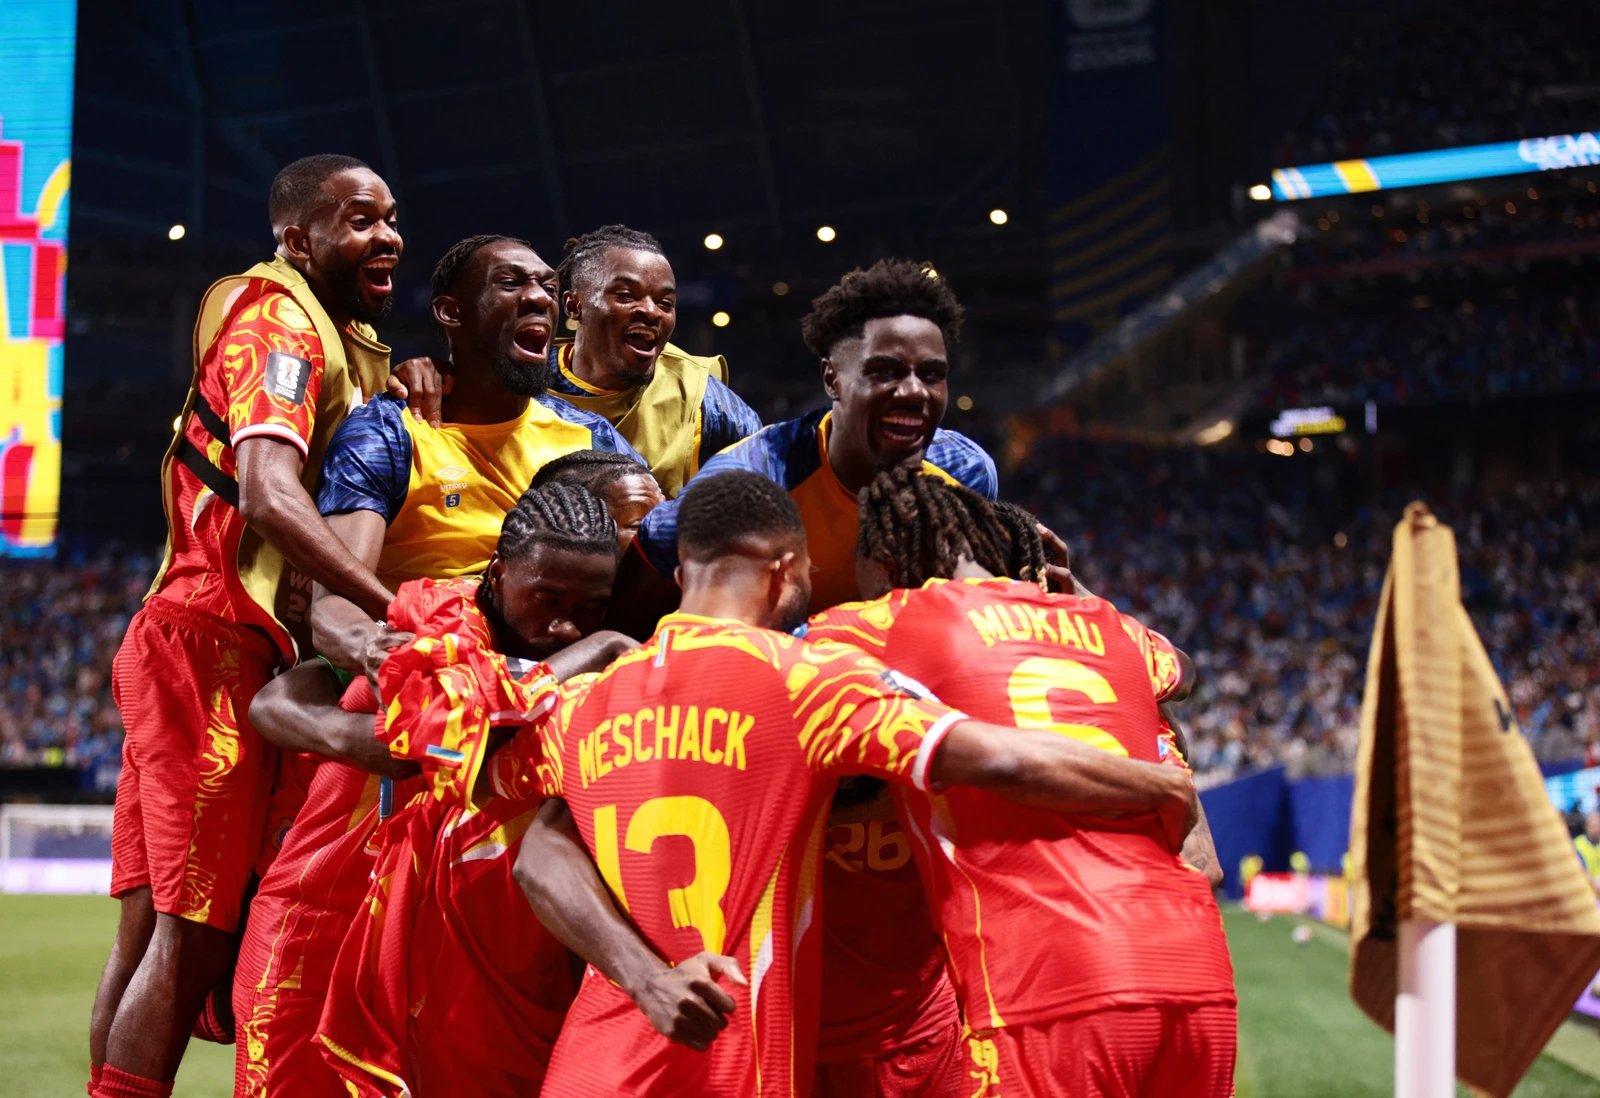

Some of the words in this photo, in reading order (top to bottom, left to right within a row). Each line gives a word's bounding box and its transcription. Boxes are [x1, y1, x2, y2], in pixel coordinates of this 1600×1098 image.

[440, 481, 468, 491] umbro
[449, 495, 456, 506] 5
[968, 603, 1105, 657] MUKAU
[1007, 656, 1129, 758] 6
[578, 705, 755, 790] MESCHACK
[825, 819, 912, 873] 26
[594, 795, 731, 956] 13
